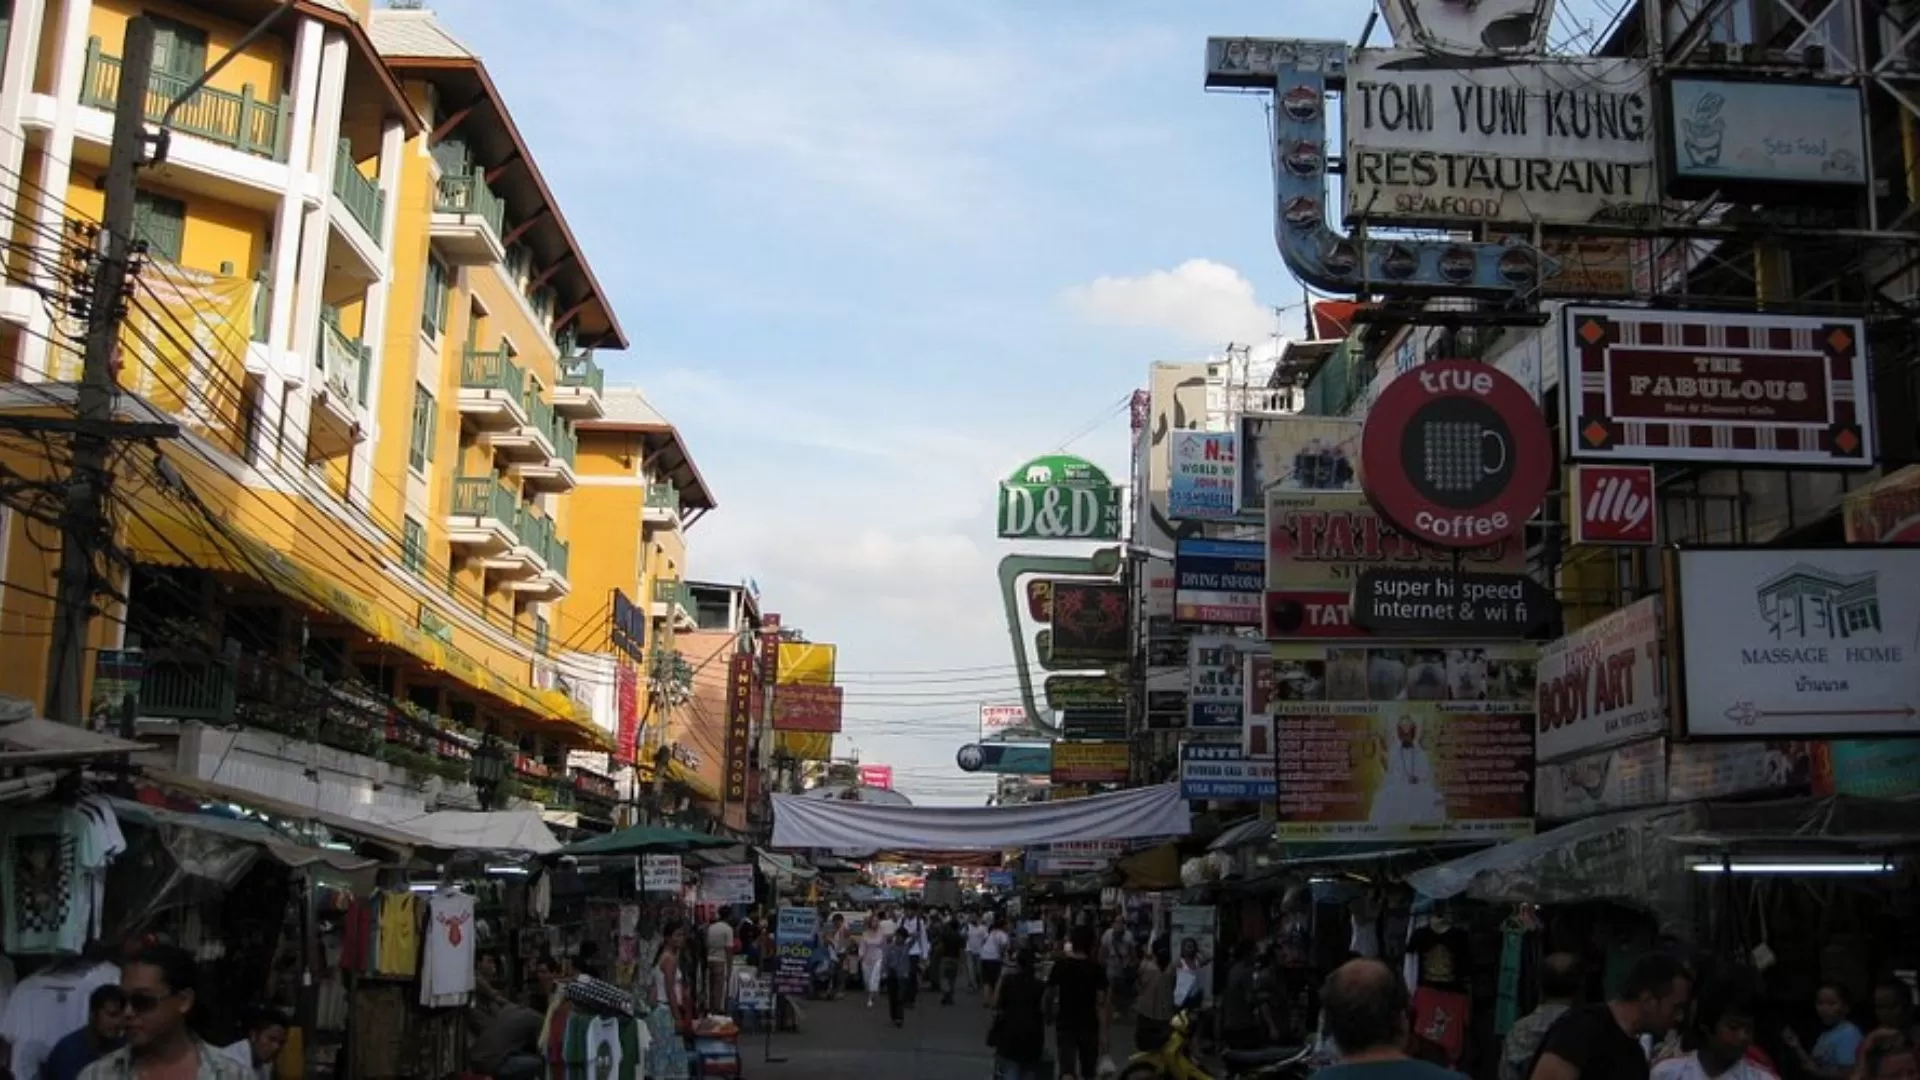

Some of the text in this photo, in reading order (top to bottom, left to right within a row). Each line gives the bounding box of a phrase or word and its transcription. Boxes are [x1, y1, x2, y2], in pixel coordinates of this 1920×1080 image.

[1357, 81, 1646, 142] TOM YUM KUNG
[1356, 152, 1634, 195] RESTAURANT
[1693, 356, 1743, 373] THE
[1419, 368, 1494, 395] true
[1629, 375, 1808, 402] FABULOUS
[1180, 463, 1218, 475] WORLD
[1003, 485, 1100, 537] D&D
[1104, 489, 1118, 538] INN
[1585, 476, 1650, 534] illy
[1415, 510, 1510, 538] coffee
[1181, 572, 1218, 588] DIVING
[1373, 577, 1524, 602] super hi speed
[1200, 606, 1252, 621] TOURIST
[1373, 599, 1528, 623] internet & wi fi
[1741, 646, 1904, 665] MASSAGE HOME
[734, 659, 749, 737] INDIAN
[1193, 685, 1217, 696] BAR
[1539, 664, 1591, 733] BODY
[1594, 647, 1636, 717] ART
[731, 745, 744, 797] FOOD
